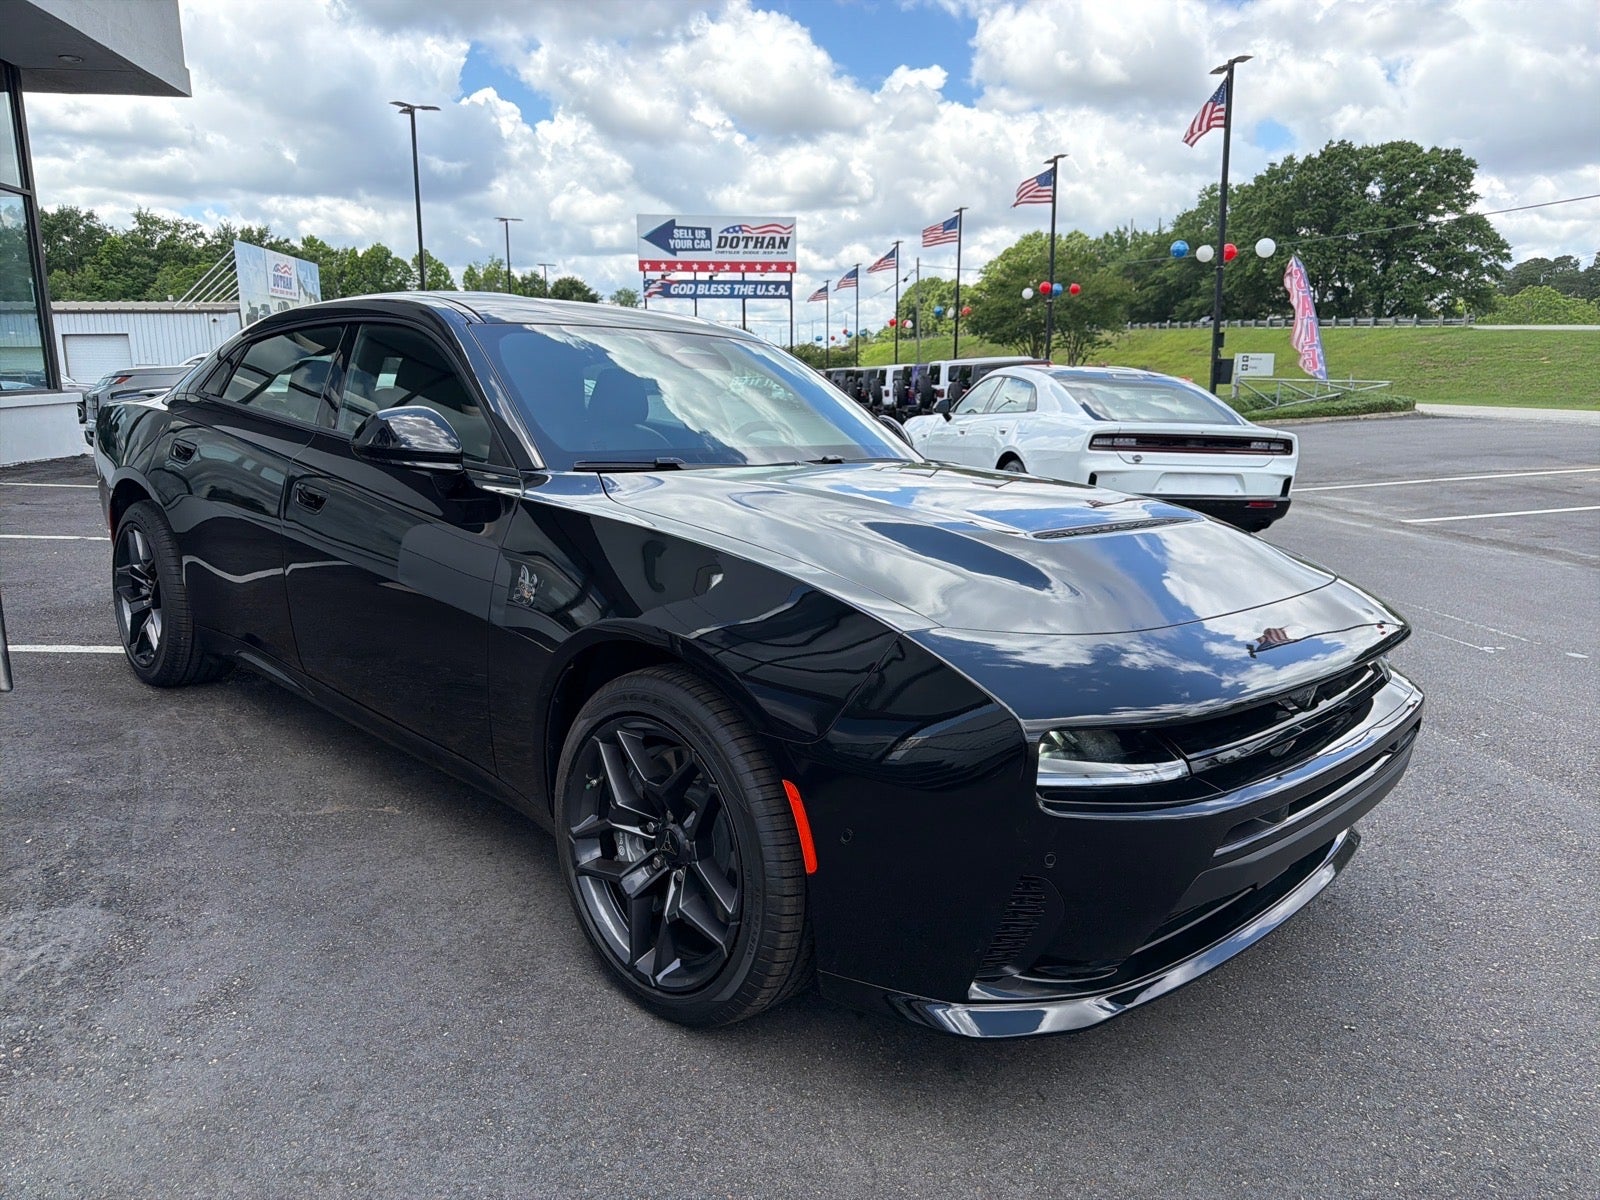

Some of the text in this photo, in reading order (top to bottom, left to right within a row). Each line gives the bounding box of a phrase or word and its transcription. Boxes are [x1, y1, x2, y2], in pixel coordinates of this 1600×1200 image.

[673, 228, 706, 239] SELL US
[669, 238, 711, 249] YOUR CAR
[716, 235, 791, 250] DOTHAN
[670, 283, 789, 296] GOD BLESS THE U.S.A.
